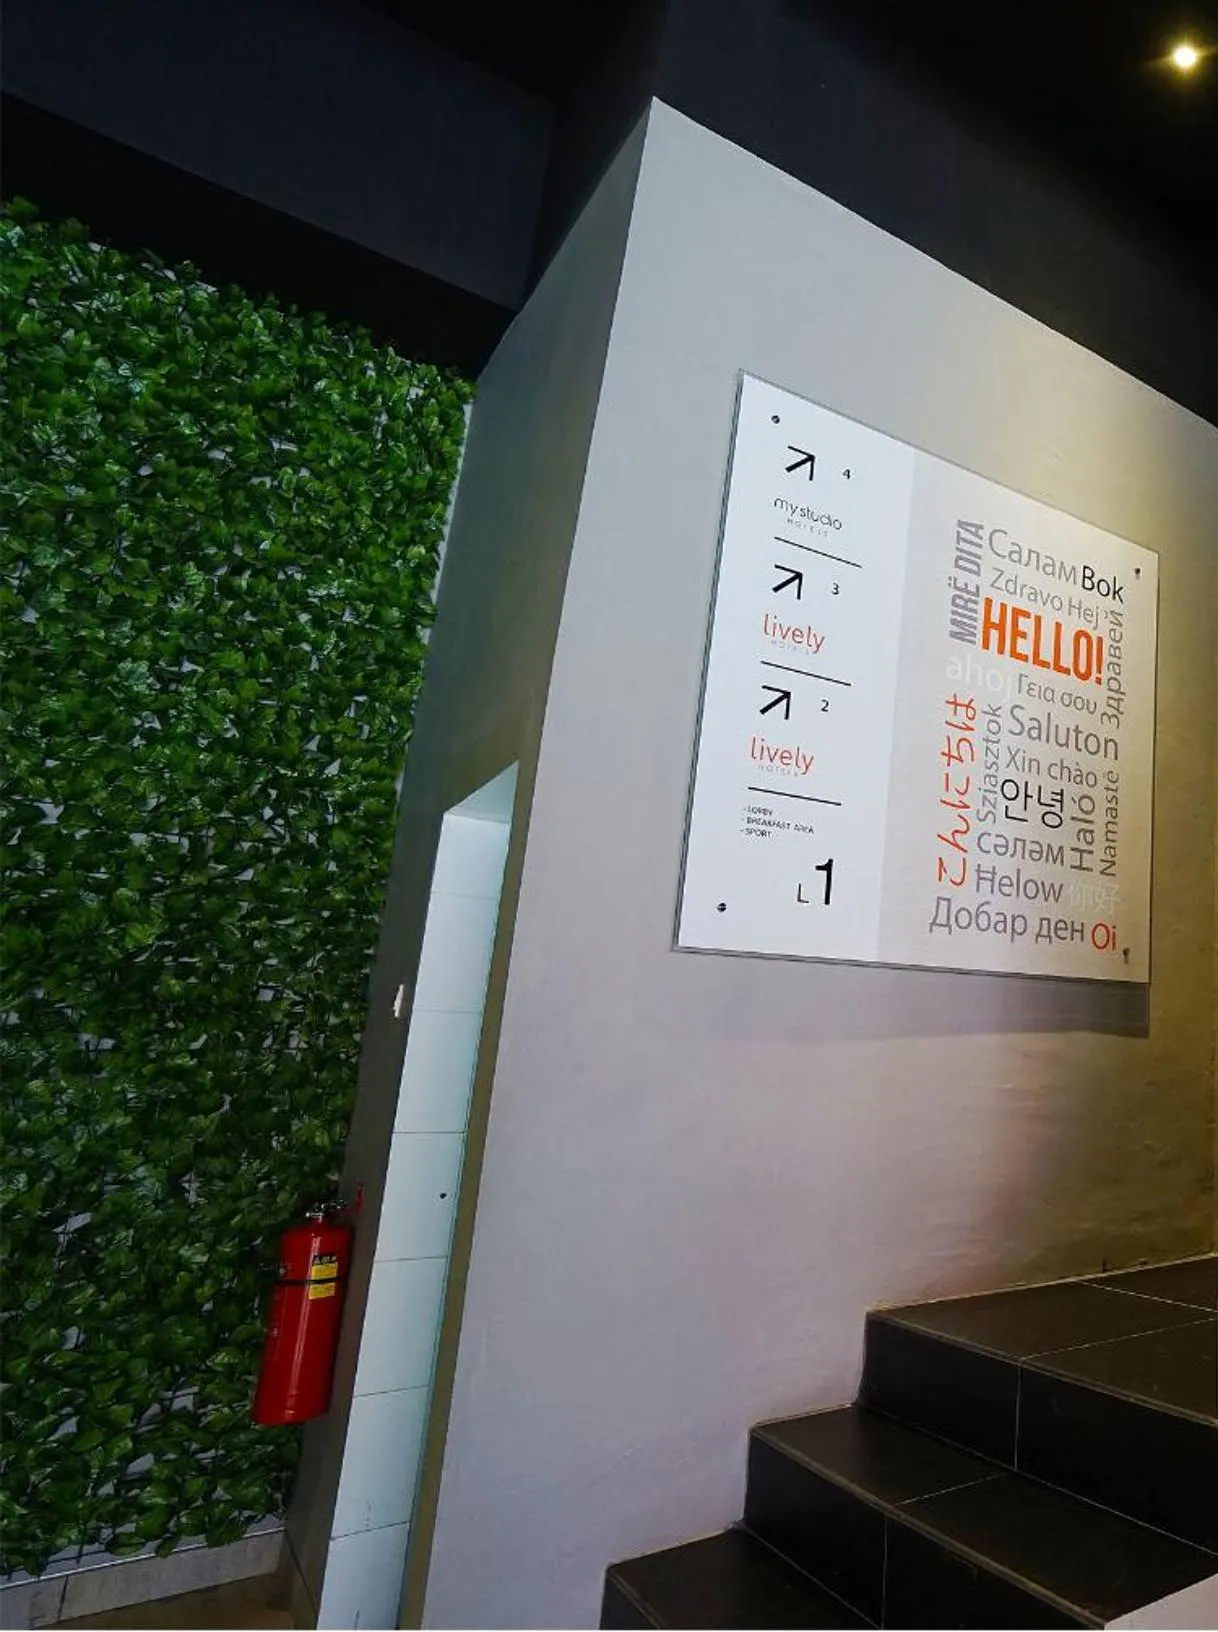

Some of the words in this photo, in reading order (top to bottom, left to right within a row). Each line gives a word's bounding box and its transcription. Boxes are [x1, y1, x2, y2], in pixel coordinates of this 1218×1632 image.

[842, 468, 852, 480] 4
[954, 519, 985, 577] DITA
[988, 528, 1077, 586] Салам
[831, 582, 840, 596] 3
[990, 567, 1063, 612] Zdravo
[1081, 564, 1125, 605] Bok
[763, 613, 825, 655] lively
[947, 575, 980, 646] MIRË
[1068, 598, 1100, 630] Hej
[981, 597, 1104, 686] HELLO!
[945, 652, 1014, 704] ahoj
[820, 699, 830, 712] 2
[750, 736, 815, 776] lively
[1008, 704, 1119, 761] Saluton
[976, 703, 1003, 824] Sziasztok
[1005, 745, 1041, 777] Xin
[936, 693, 977, 887] こんにちは
[1000, 778, 1065, 829] 안녕
[1070, 794, 1097, 873] Haló
[928, 895, 1028, 943] Добар
[1035, 916, 1085, 945] ден
[1090, 922, 1117, 951] Oi
